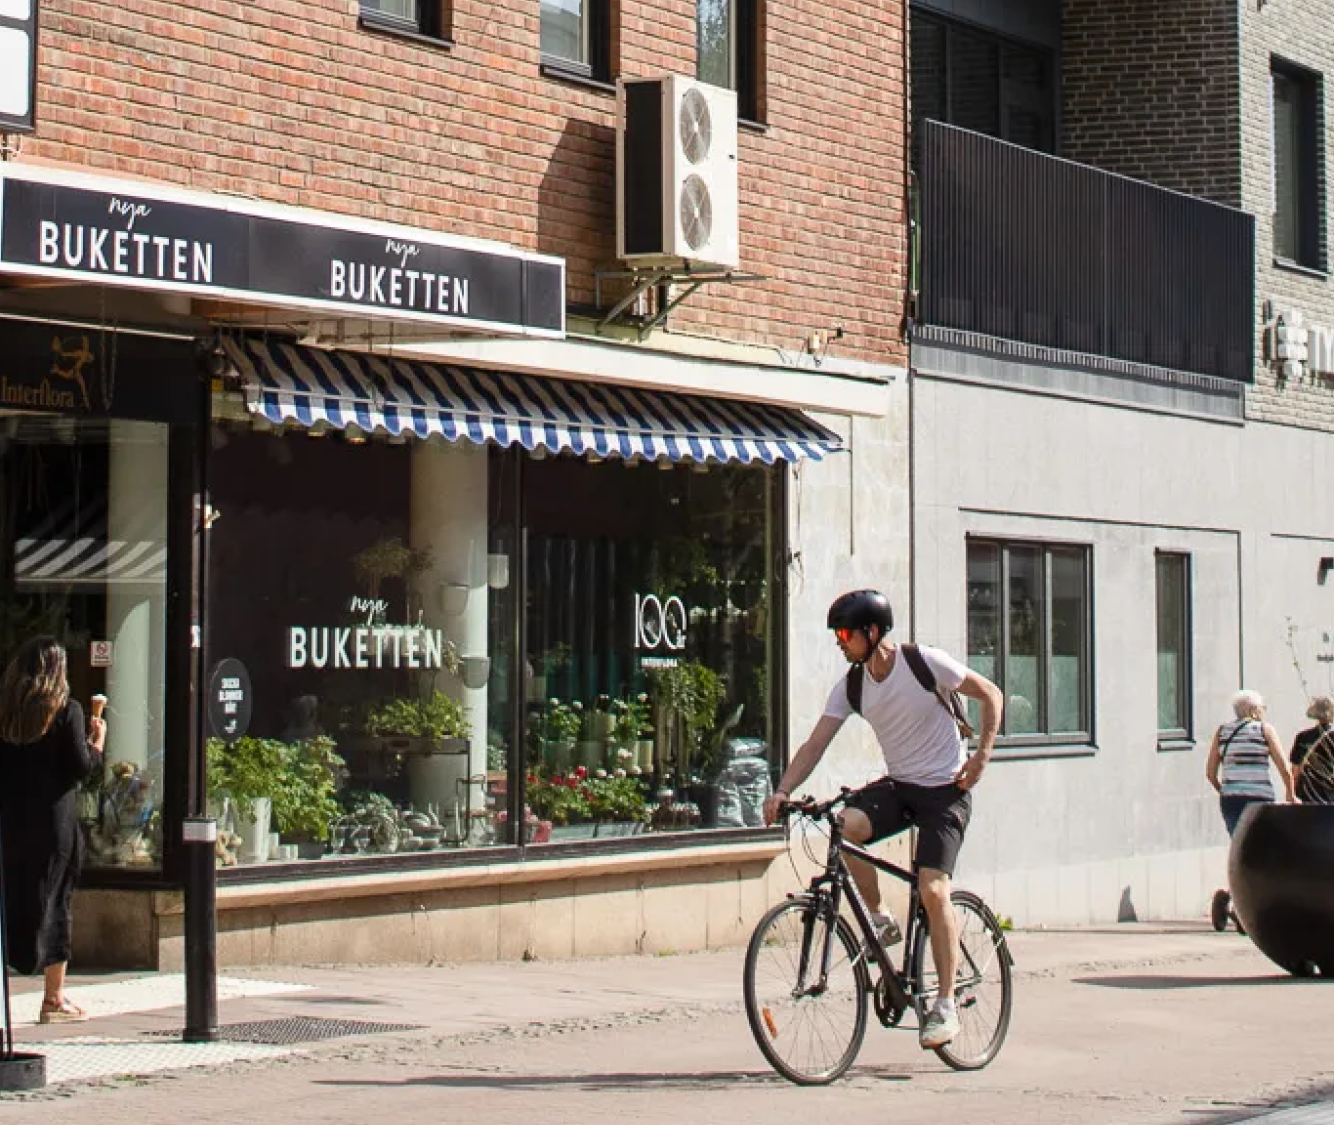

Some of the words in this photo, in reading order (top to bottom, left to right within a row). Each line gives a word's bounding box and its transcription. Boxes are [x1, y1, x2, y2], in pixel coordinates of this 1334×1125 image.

[108, 194, 152, 229] nya
[39, 220, 214, 283] BUKETTEN
[385, 236, 420, 261] nya
[330, 260, 469, 314] BUKETTEN
[0, 377, 76, 408] Interflora
[290, 626, 443, 669] BUKETTEN
